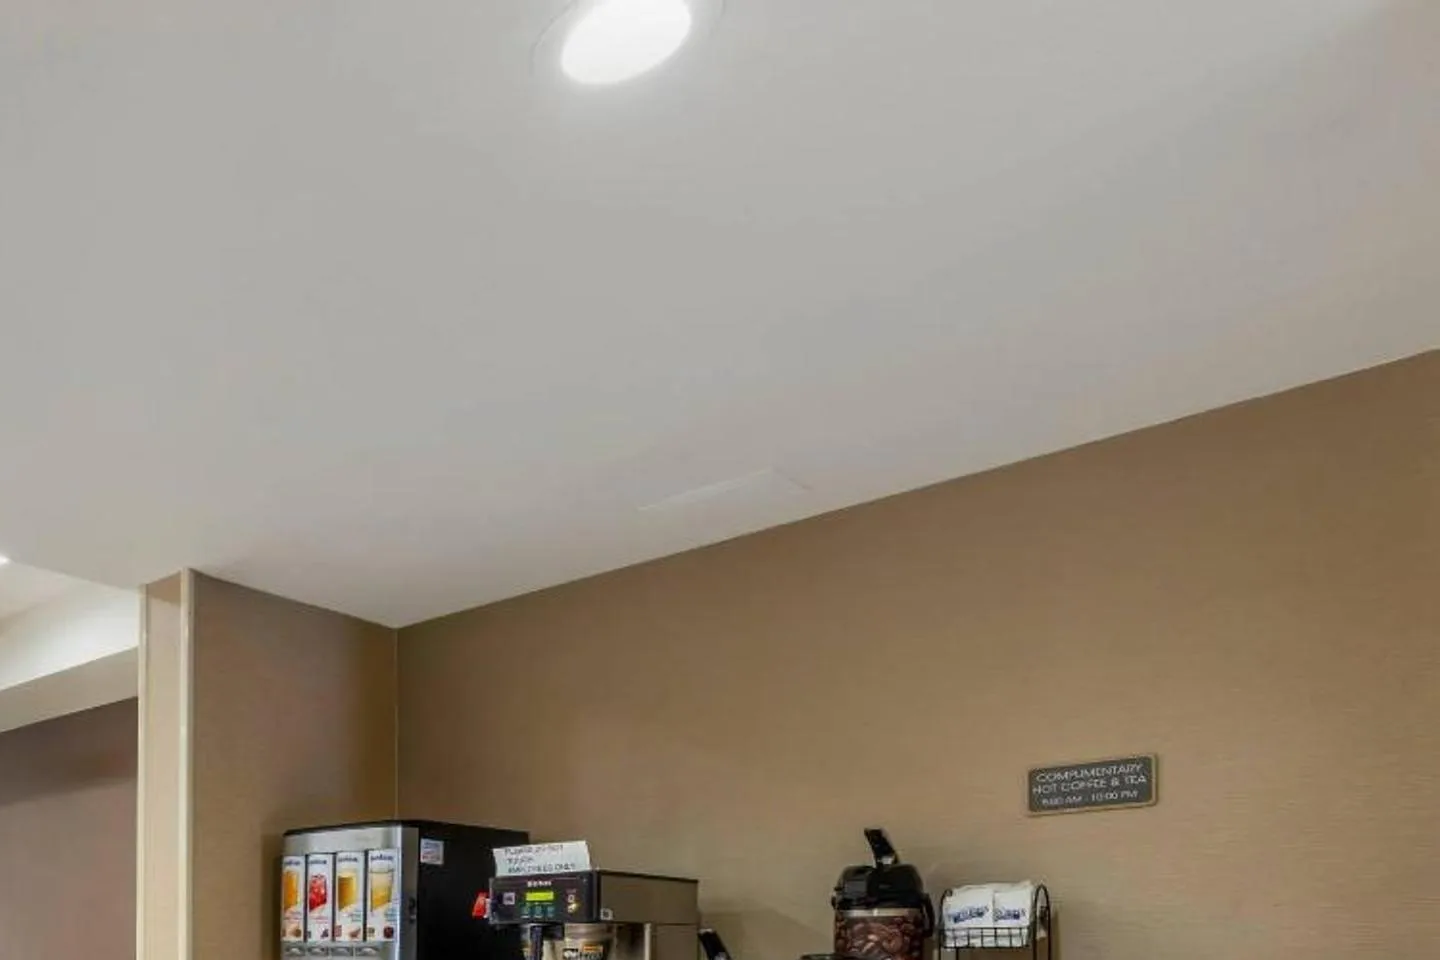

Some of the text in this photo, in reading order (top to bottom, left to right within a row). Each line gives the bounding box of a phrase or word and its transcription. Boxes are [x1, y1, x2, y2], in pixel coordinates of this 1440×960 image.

[1035, 763, 1144, 783] COMPLIMENTARY
[1032, 783, 1058, 795] HOT
[1061, 778, 1108, 793] COFFEE
[1125, 774, 1148, 785] TEA
